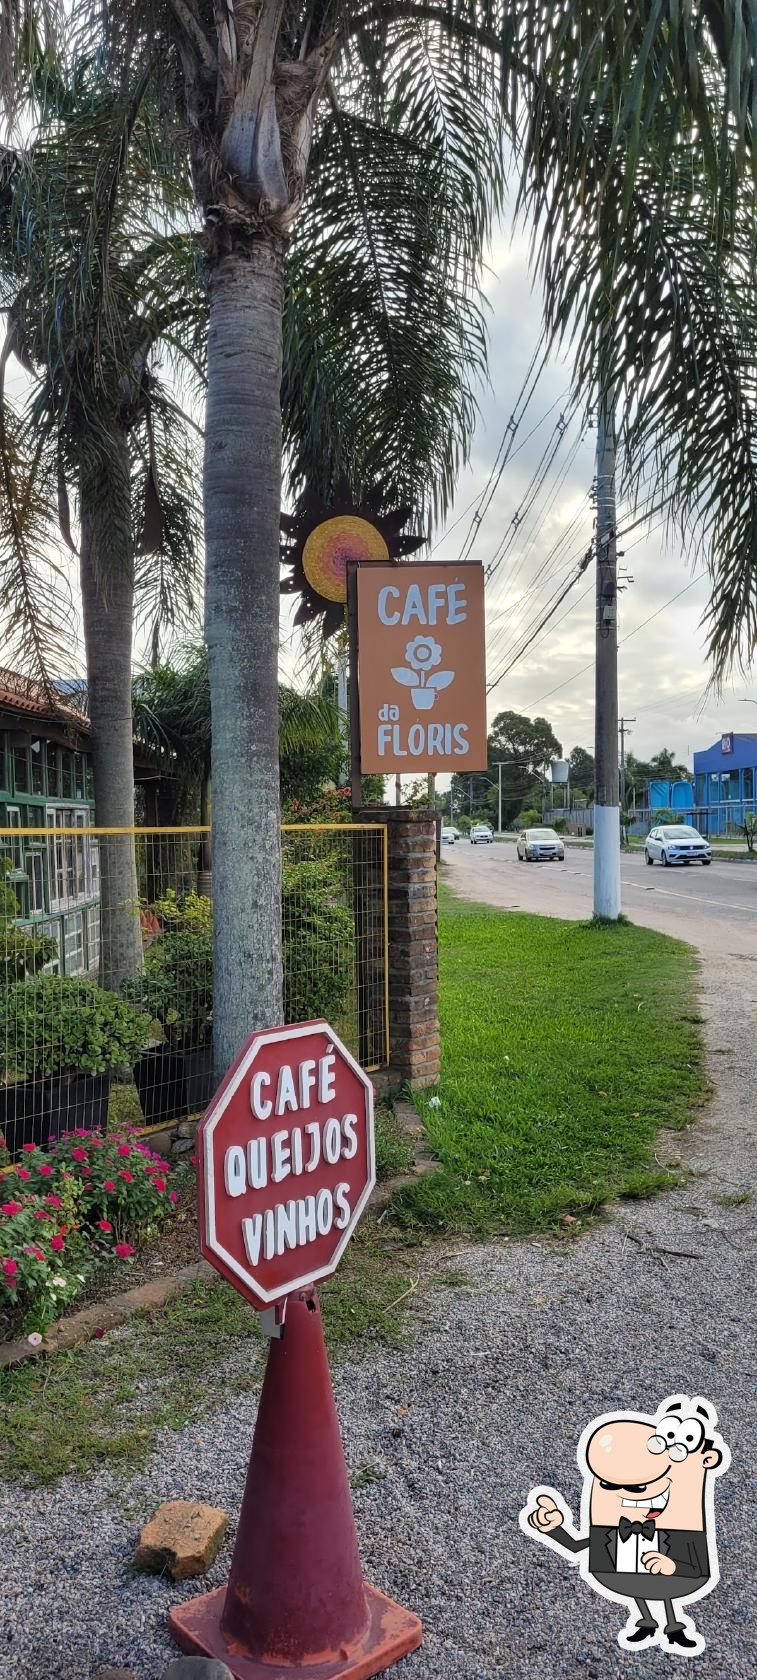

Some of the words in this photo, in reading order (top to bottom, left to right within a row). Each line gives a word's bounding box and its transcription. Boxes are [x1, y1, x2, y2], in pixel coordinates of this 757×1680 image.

[378, 577, 467, 626] CAFÉ
[378, 703, 400, 721] da
[251, 1044, 336, 1120] CAFÉ
[224, 1114, 358, 1198] QUEIJOS
[242, 1183, 351, 1266] VINHOS
